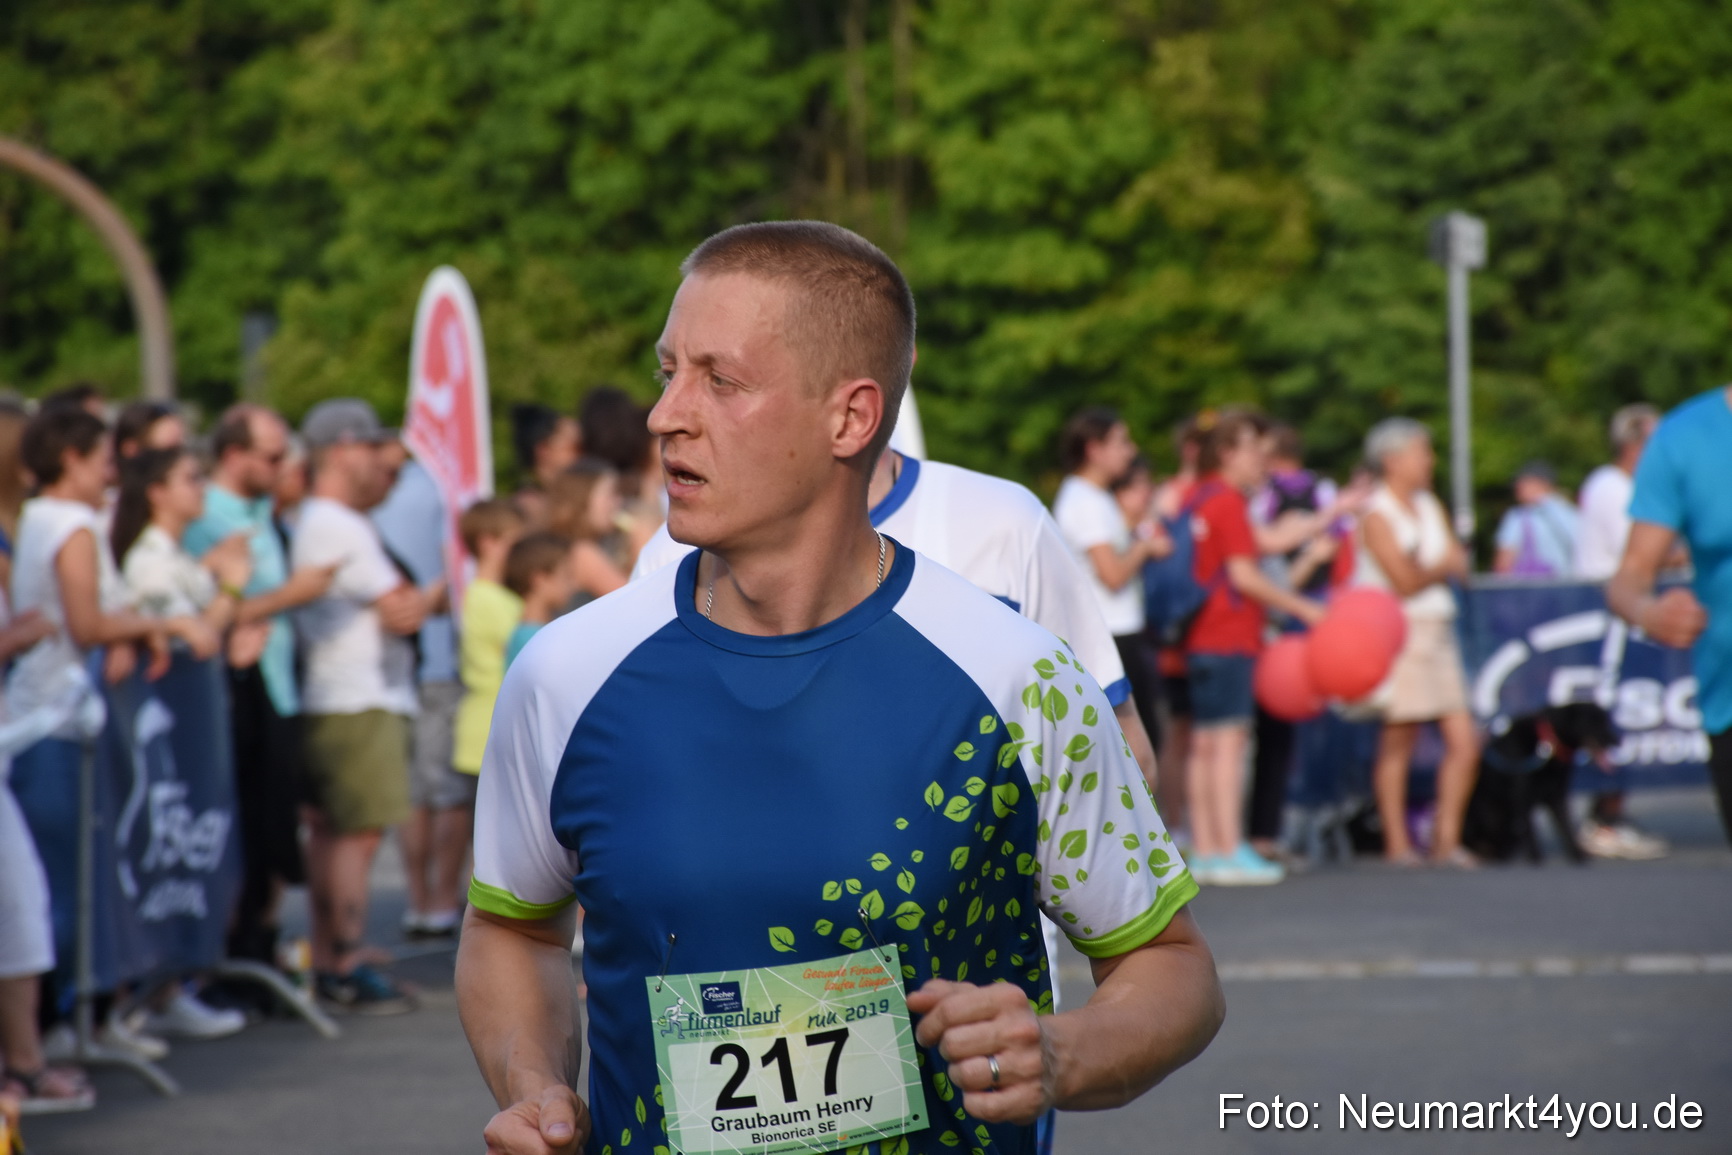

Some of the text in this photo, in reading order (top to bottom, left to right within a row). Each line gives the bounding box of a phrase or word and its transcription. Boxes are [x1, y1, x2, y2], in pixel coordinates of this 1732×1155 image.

[687, 1004, 782, 1031] firmenlauf
[845, 999, 889, 1022] 2019
[689, 1029, 730, 1038] neumarkt
[709, 1027, 850, 1112] 217
[711, 1095, 873, 1132] Graubaum Henry
[752, 1128, 815, 1145] Bionorica
[818, 1120, 837, 1134] SE
